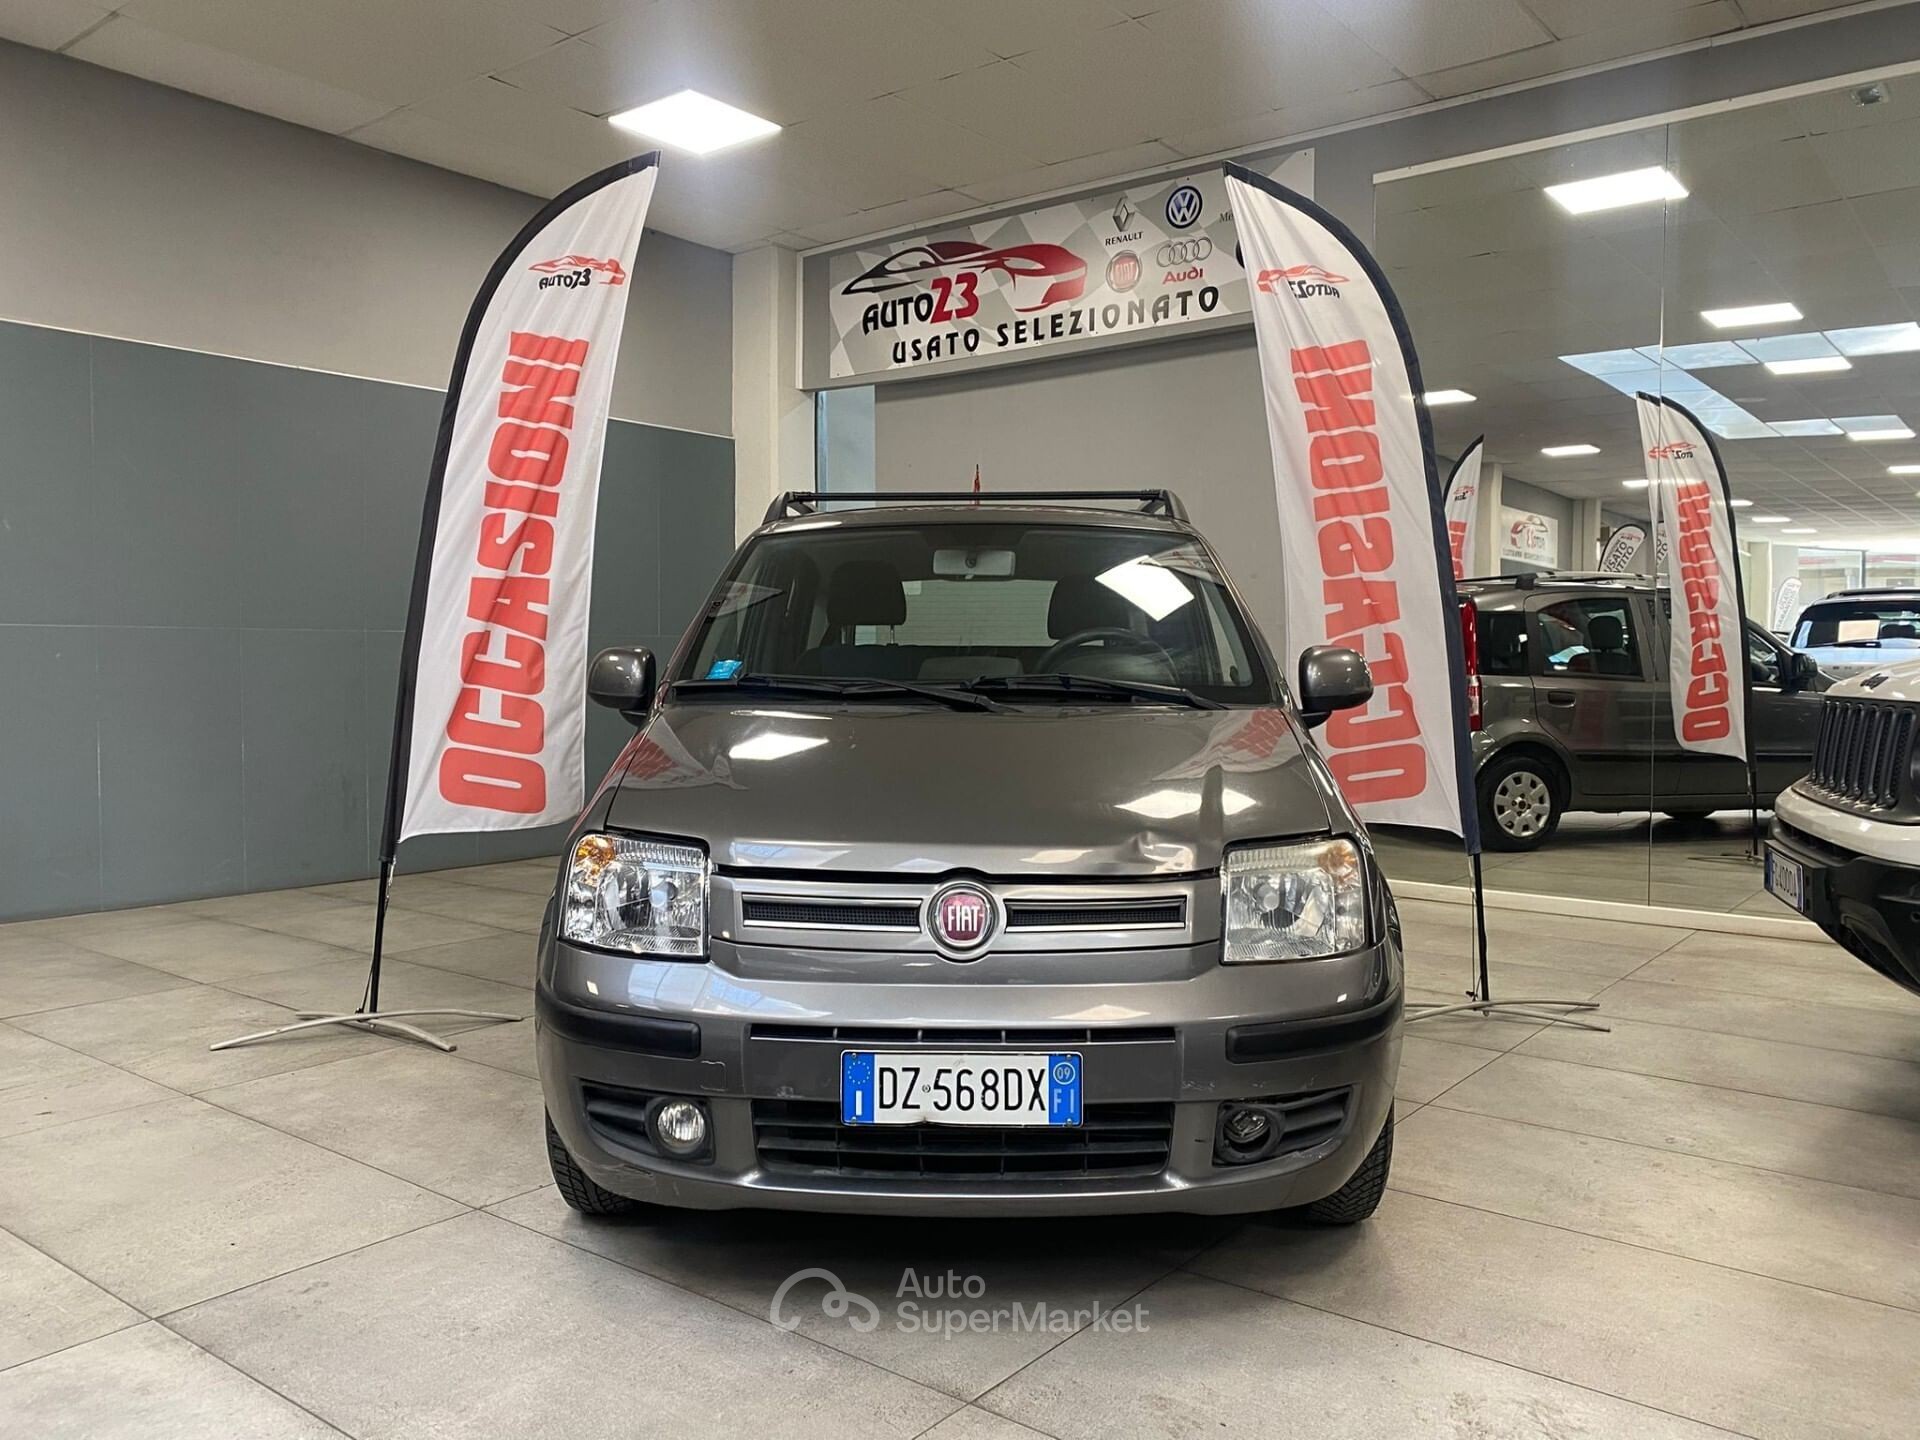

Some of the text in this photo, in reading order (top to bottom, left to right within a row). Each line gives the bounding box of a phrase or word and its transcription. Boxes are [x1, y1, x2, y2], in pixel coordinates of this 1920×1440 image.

[1104, 231, 1144, 247] RENAULT
[1113, 260, 1136, 284] FIAT
[1162, 268, 1204, 285] Audi
[862, 271, 980, 336] AUTO23
[892, 286, 1219, 364] USATO SELEZIONATO
[438, 331, 590, 814] OCCASIONI
[947, 905, 981, 932] FIAT
[1056, 1066, 1072, 1080] 09
[879, 1067, 921, 1110] DZ
[932, 1068, 1046, 1112] 568DX
[1053, 1088, 1075, 1114] FI
